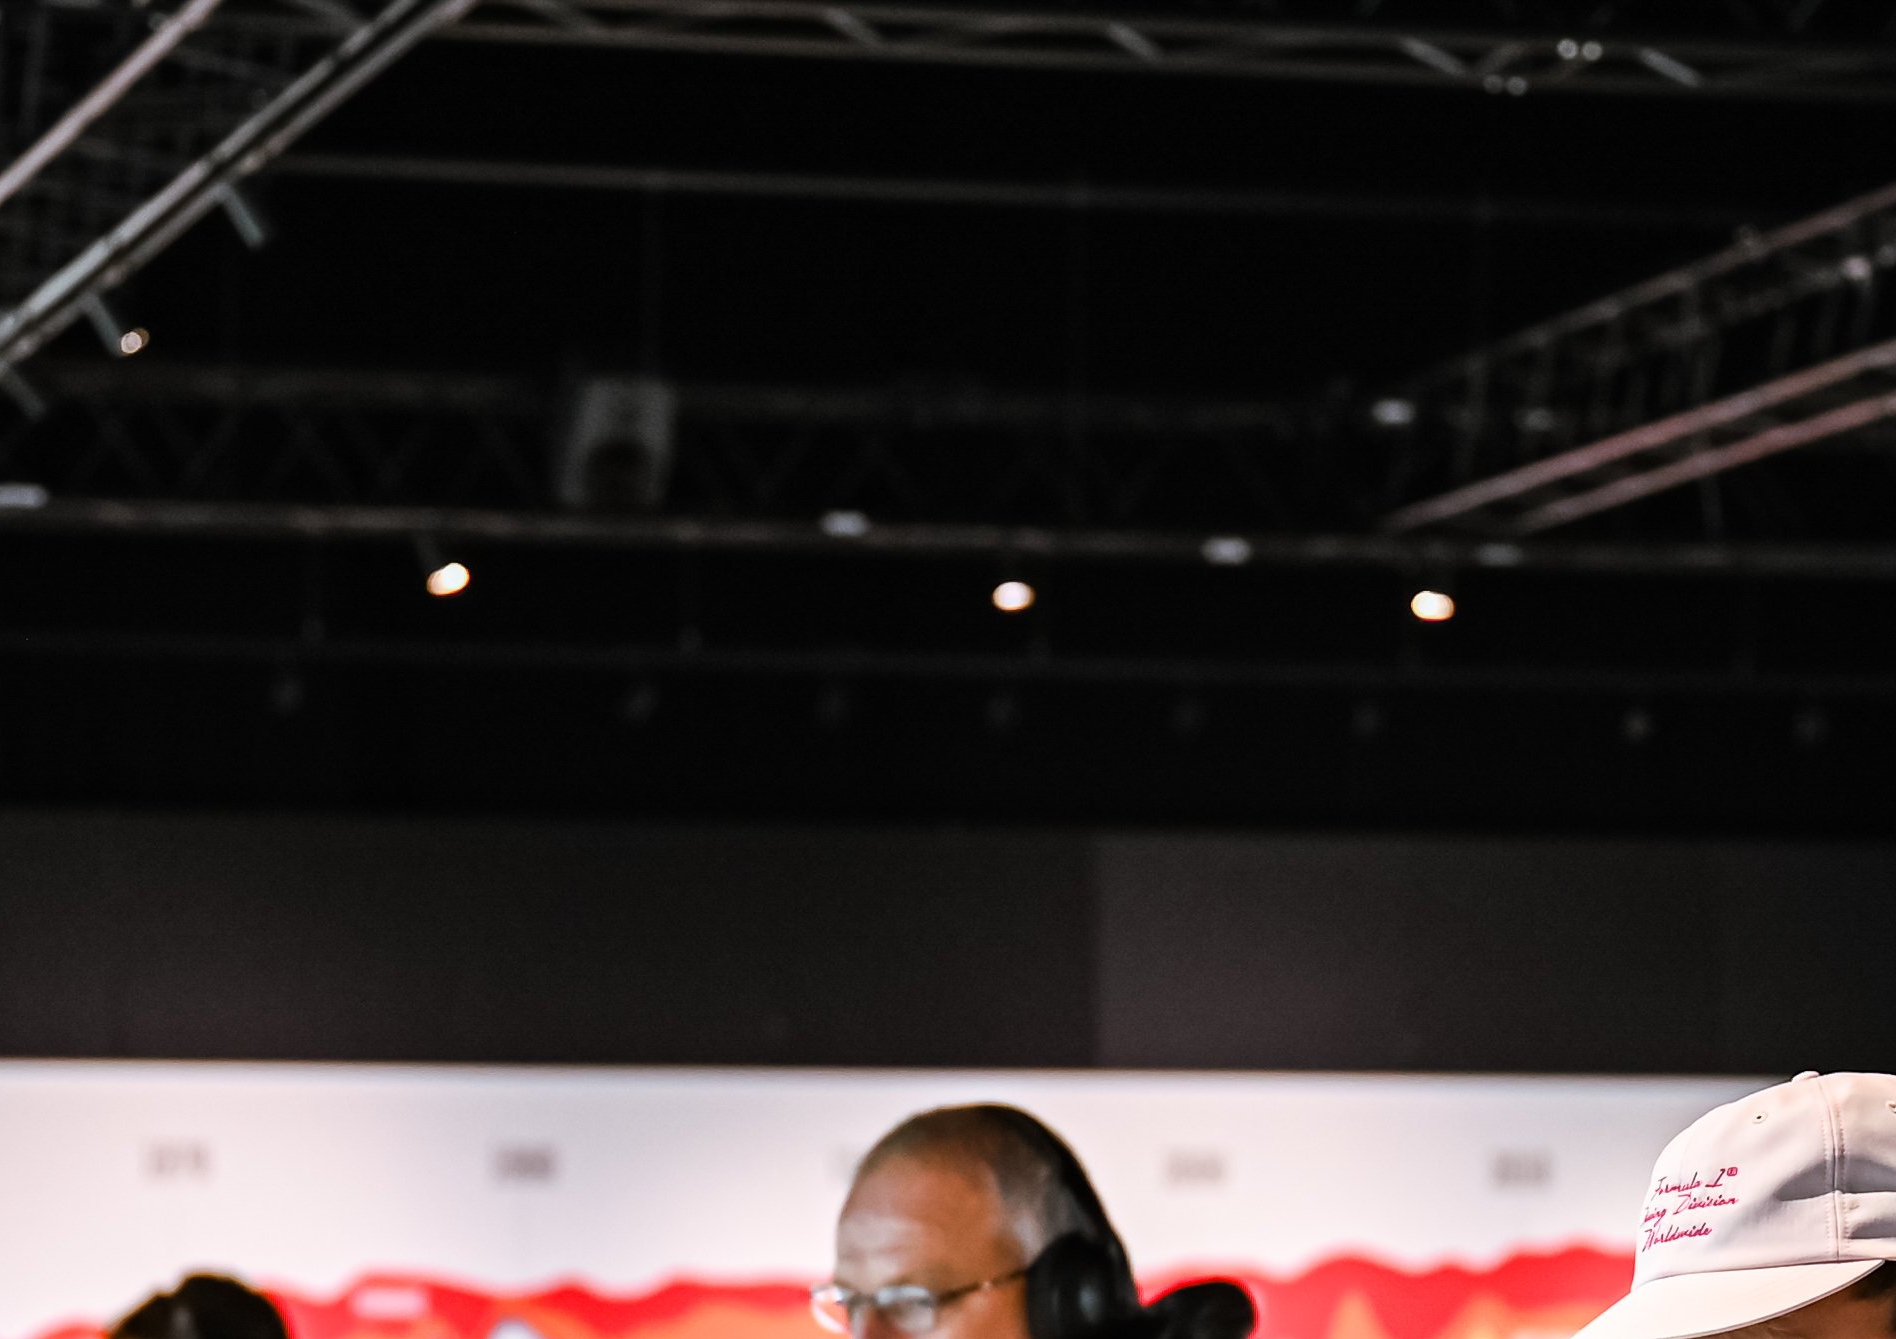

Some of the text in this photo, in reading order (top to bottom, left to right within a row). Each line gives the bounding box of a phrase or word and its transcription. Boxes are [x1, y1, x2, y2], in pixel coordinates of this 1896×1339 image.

[1651, 1172, 1702, 1201] Formula
[1672, 1191, 1739, 1215] Division
[1642, 1223, 1713, 1252] Worldwide
